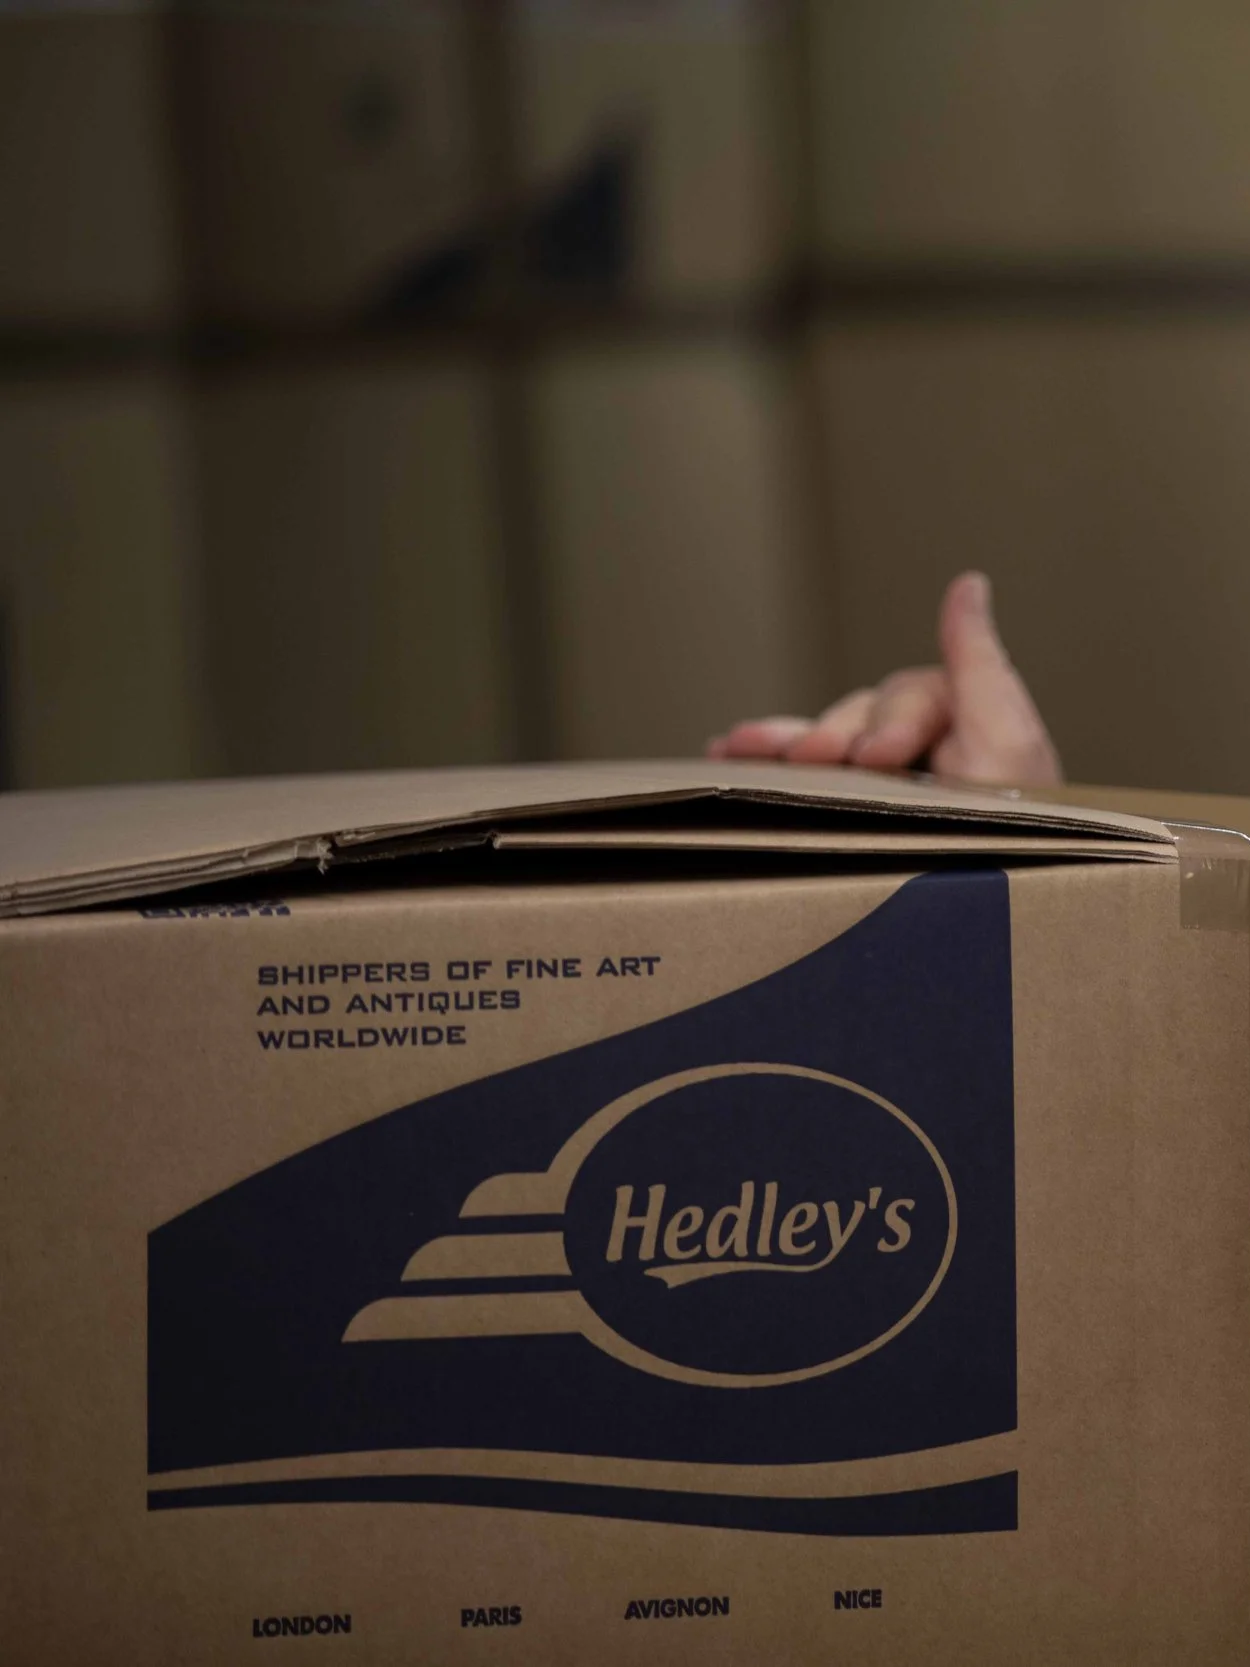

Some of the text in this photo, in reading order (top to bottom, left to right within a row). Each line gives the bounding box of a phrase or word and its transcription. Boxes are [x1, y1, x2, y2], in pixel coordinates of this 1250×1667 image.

[258, 957, 661, 985] SHIPPERS OF FINE ART
[257, 990, 521, 1016] AND ANTIQUES
[258, 1026, 466, 1050] WORLDWIDE
[605, 1180, 916, 1288] Hedley's
[252, 1589, 883, 1638] LONDON PARIS AVIGNON NICE
